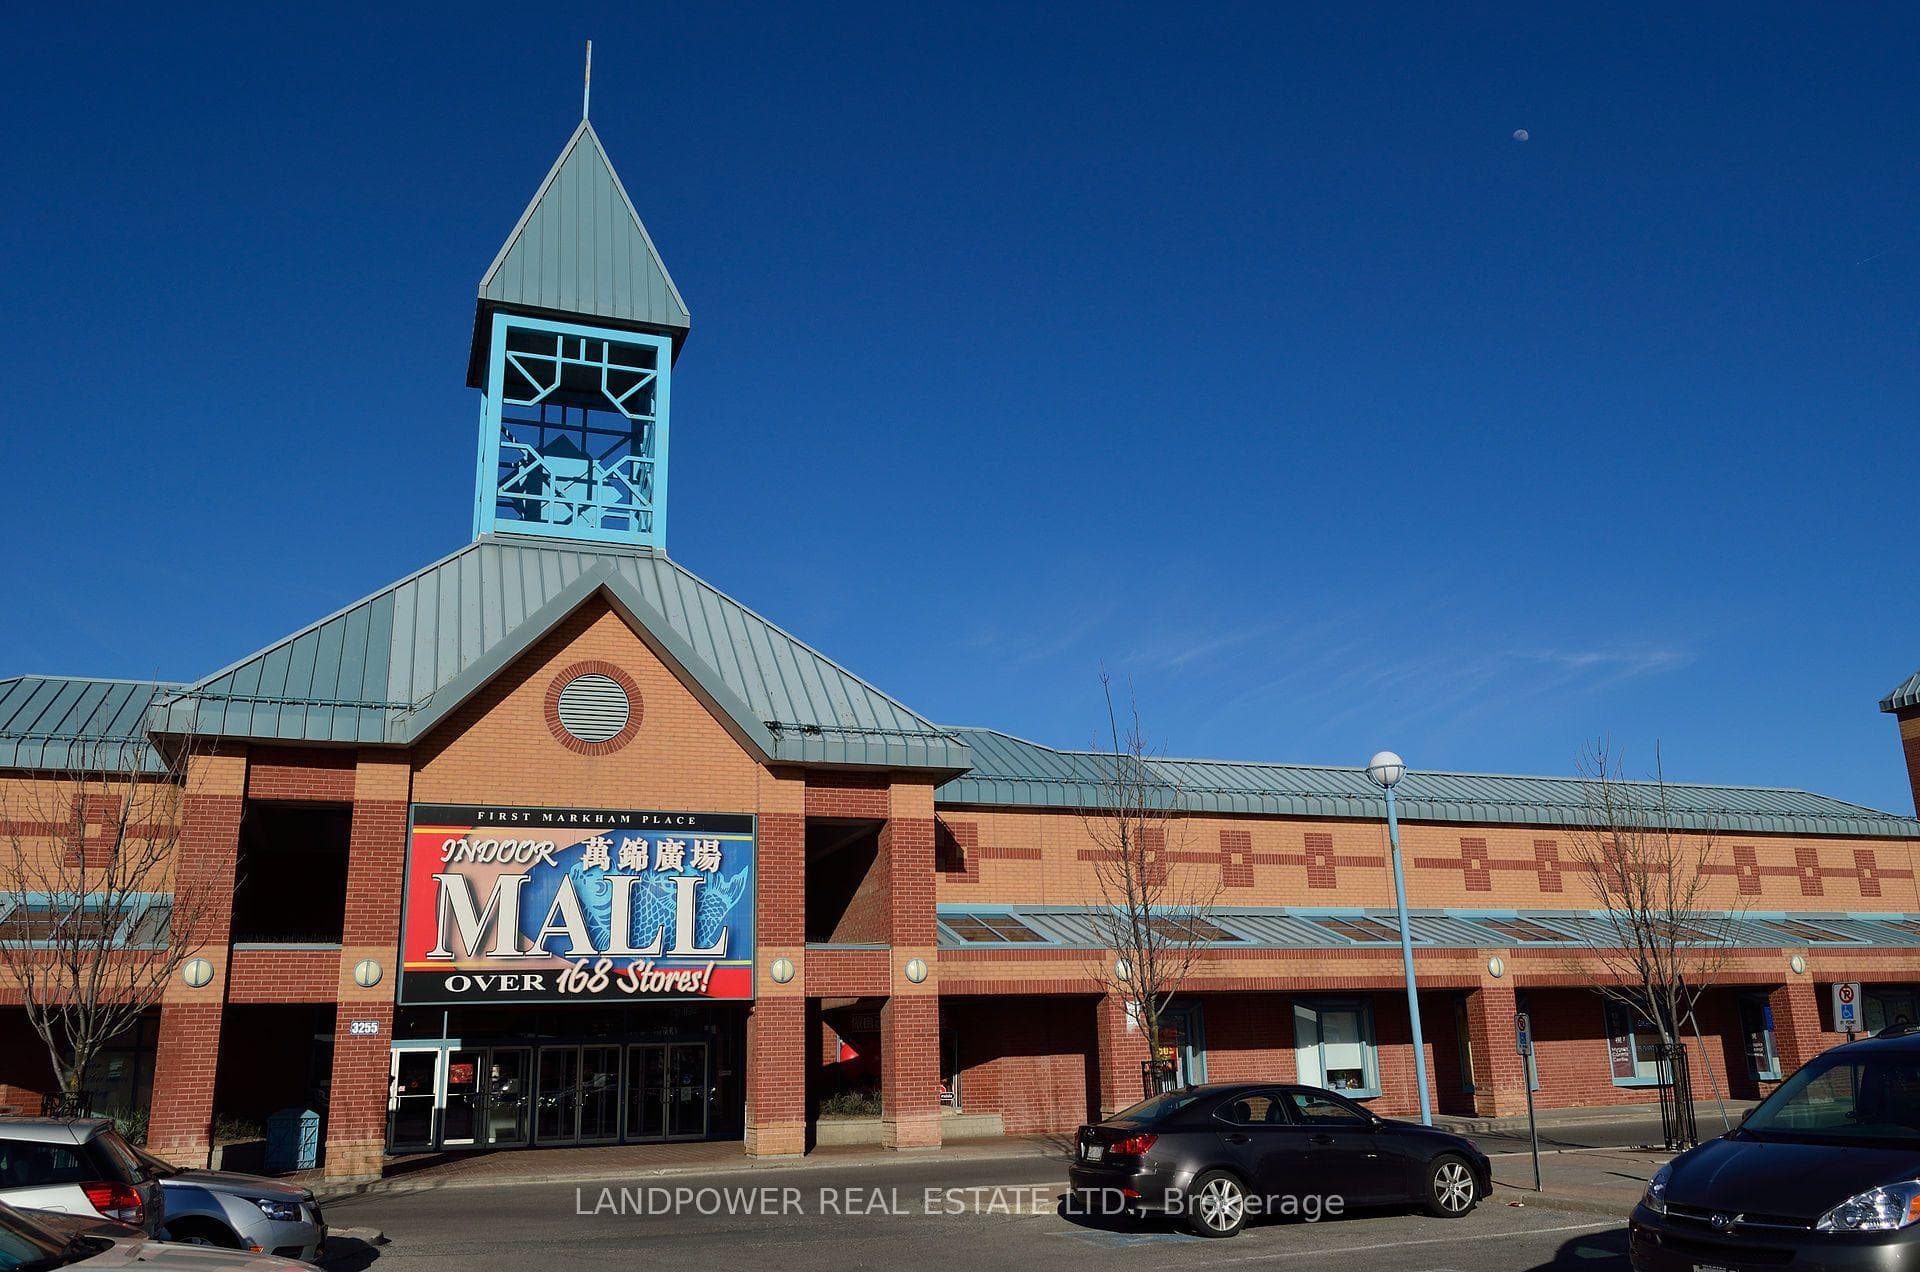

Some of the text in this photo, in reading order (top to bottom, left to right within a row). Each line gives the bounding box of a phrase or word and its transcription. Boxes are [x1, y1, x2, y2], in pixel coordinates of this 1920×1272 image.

[477, 810, 697, 825] FIRST MARKHAM PLACE
[440, 838, 558, 867] INDOOR
[580, 837, 723, 873] 萬錦廣場
[426, 873, 729, 960] MALL
[444, 958, 713, 995] OVER 168 Stores!
[352, 1022, 378, 1034] 3255
